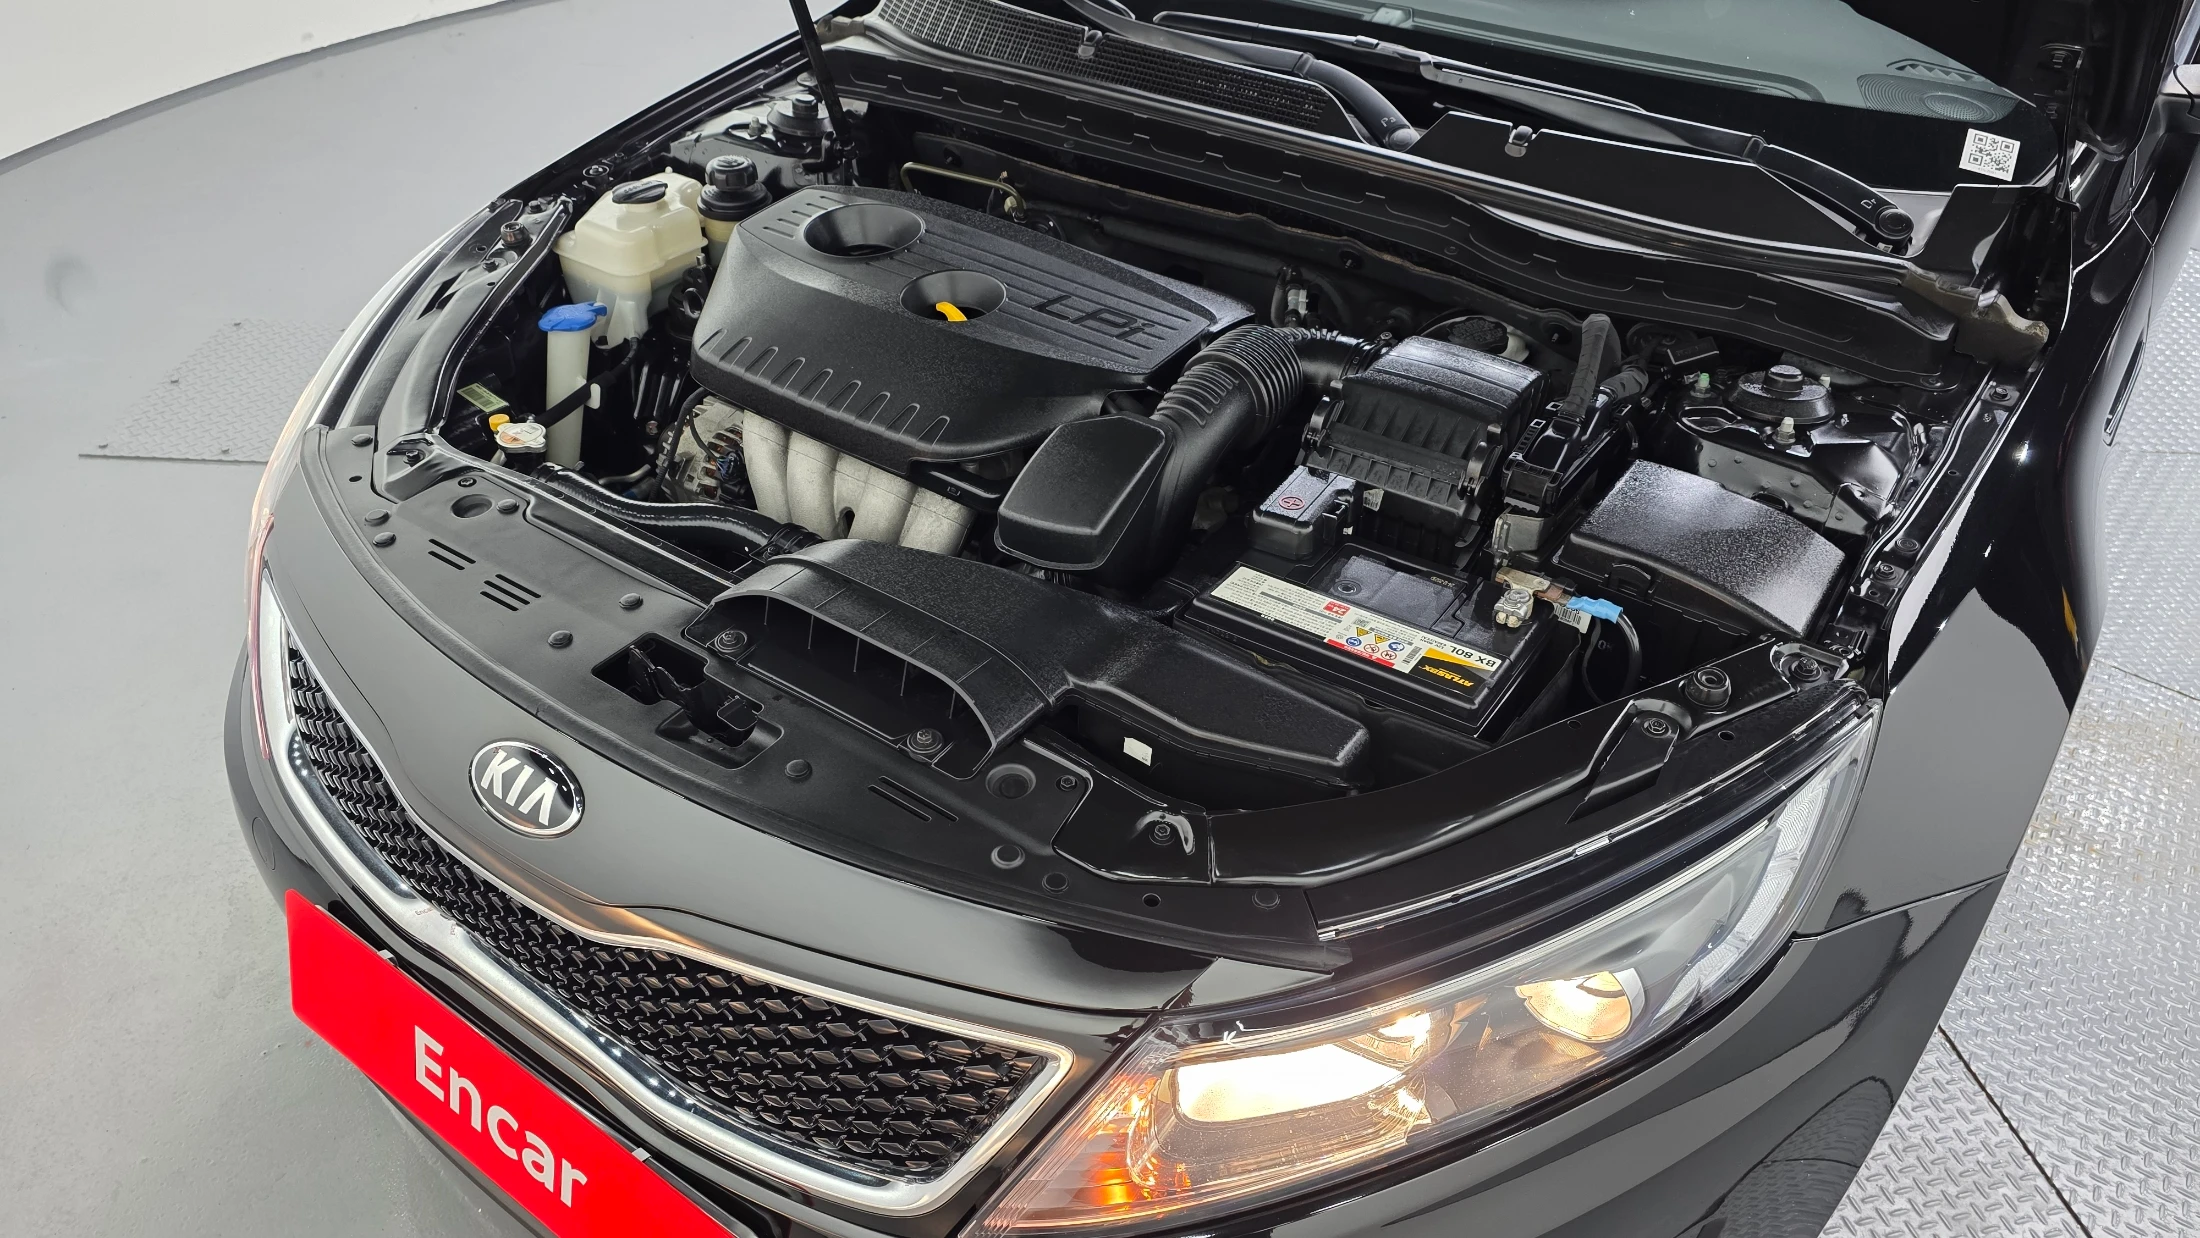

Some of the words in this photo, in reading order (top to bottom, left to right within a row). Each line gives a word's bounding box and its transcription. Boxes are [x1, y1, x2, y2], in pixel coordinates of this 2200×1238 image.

[1450, 646, 1474, 659] 80L
[1476, 656, 1496, 667] BX
[1423, 665, 1474, 686] ATLASBX
[481, 749, 558, 826] KIA
[415, 1025, 588, 1208] Encar
